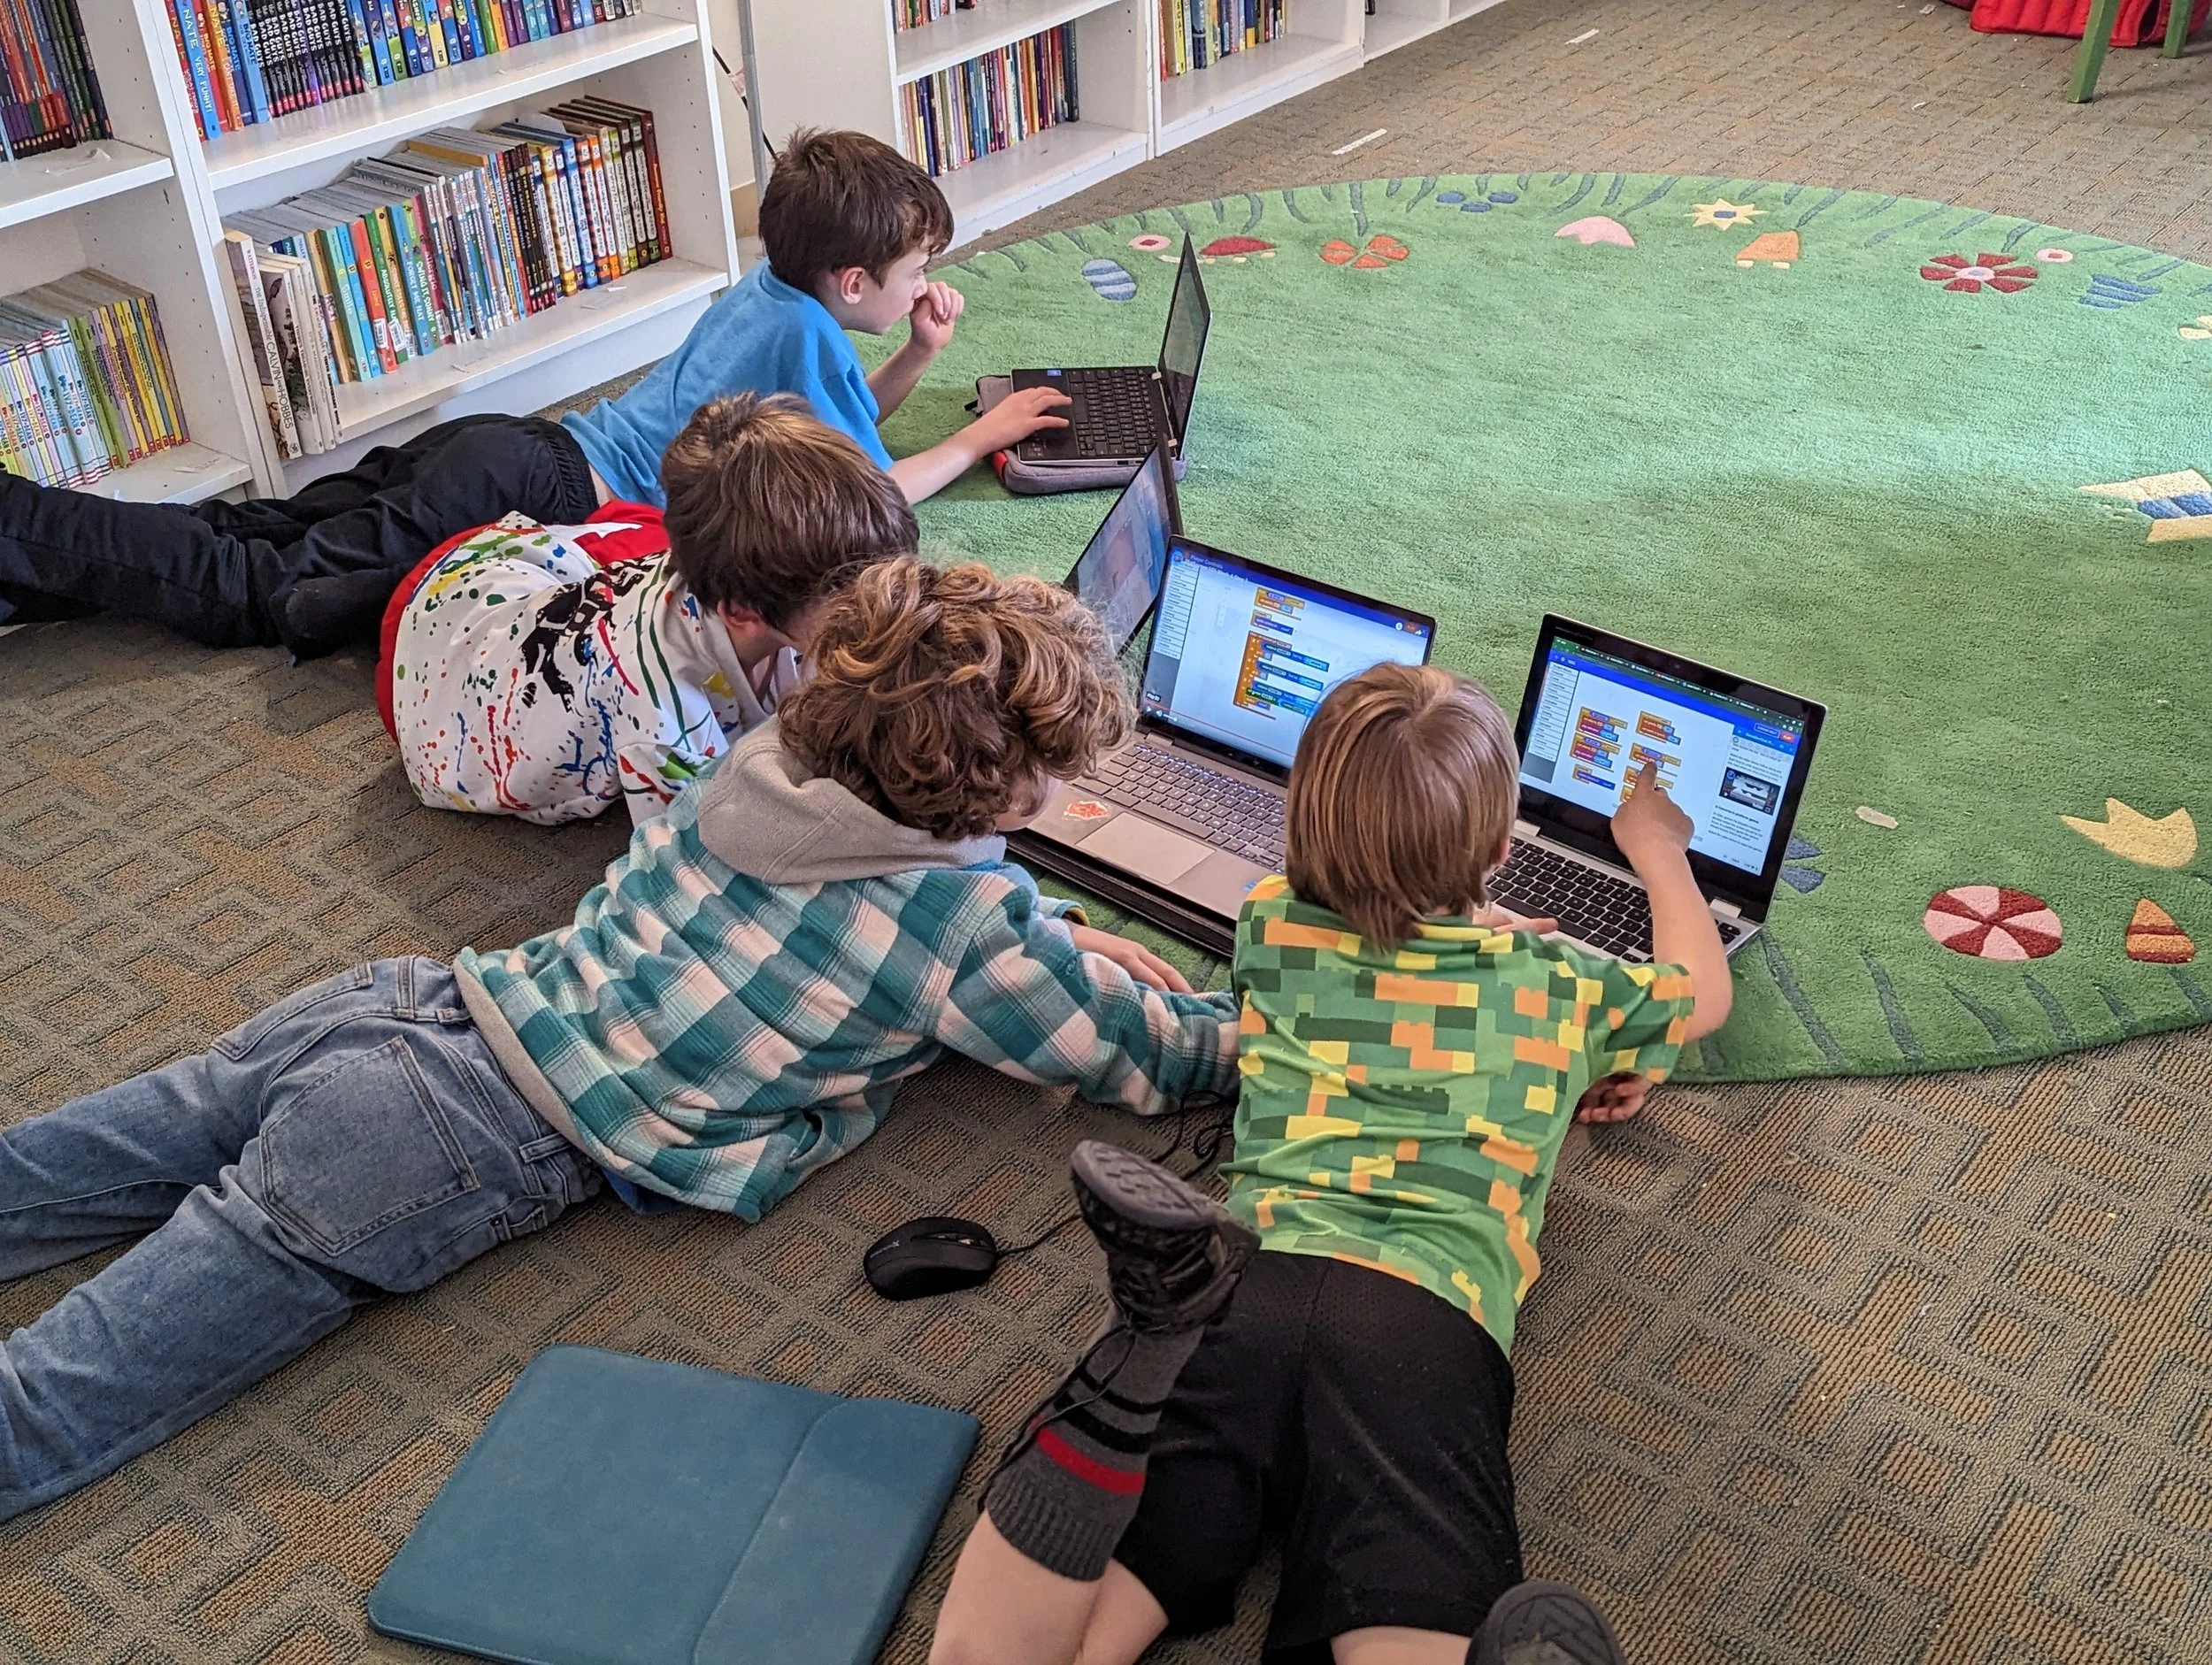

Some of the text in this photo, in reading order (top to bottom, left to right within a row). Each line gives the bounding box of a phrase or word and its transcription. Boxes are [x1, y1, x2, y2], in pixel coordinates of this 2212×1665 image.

[208, 6, 226, 49] NATE
[225, 25, 235, 45] BIG
[257, 20, 268, 40] BAD
[264, 17, 274, 37] BAD
[270, 15, 280, 35] BAD
[279, 13, 288, 33] BAD
[286, 11, 302, 56] BAD GUYS
[292, 9, 309, 54] BAD GUYS
[302, 6, 318, 51] BAD GUYS
[308, 4, 324, 50] BAD GUYS
[316, 2, 333, 47] BAD GUYS
[326, 0, 342, 45] BAD GUYS
[336, 0, 352, 42] BAD GUYS
[182, 8, 213, 113] NATE VERY FUNNY!
[206, 50, 216, 71] NATE
[229, 45, 242, 71] NATE
[242, 22, 257, 65] BIG NATE
[261, 41, 273, 66] GUYS
[267, 37, 280, 63] GUYS
[274, 35, 286, 61] GUYS
[282, 33, 295, 58] GUYS
[380, 268, 395, 309] ABSOLUTELY
[423, 249, 438, 290] allergic
[340, 283, 355, 315] Smile
[405, 260, 425, 321] FORGET ME NAT
[415, 260, 426, 288] SWING
[422, 296, 434, 322] SUNNY
[264, 341, 283, 381] CALVIN
[275, 387, 295, 429] HOBBES
